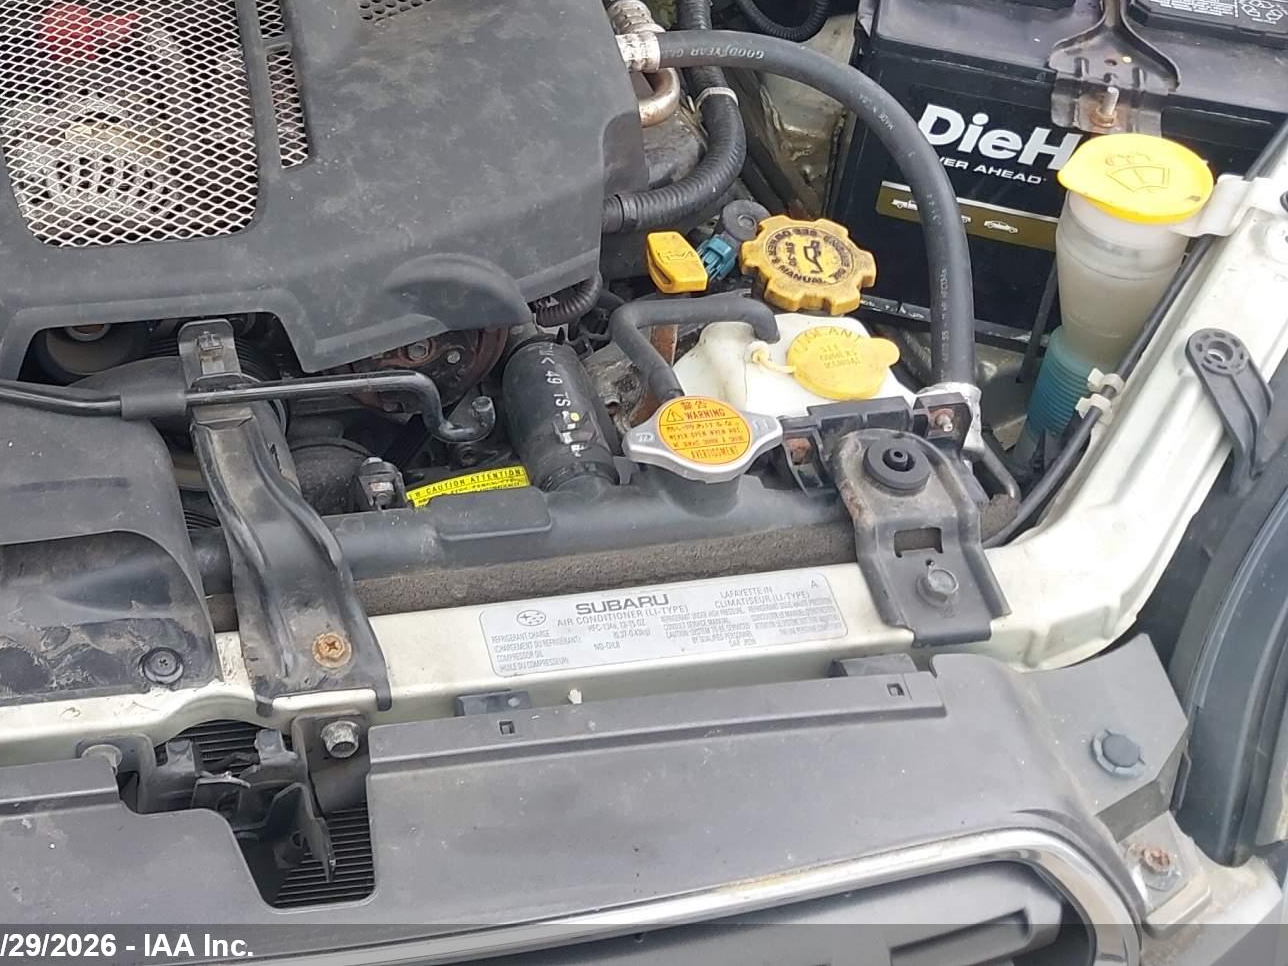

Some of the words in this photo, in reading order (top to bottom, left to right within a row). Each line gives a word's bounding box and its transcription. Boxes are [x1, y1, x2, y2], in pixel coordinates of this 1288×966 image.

[690, 44, 765, 59] GOODYEAR
[918, 103, 1084, 171] DieH
[973, 164, 1042, 185] AHEAD
[685, 409, 726, 420] WARNING
[426, 479, 466, 495] CAUTION
[470, 469, 522, 483] ATTENTION
[576, 594, 669, 616] SUBARU
[714, 596, 772, 609] CLIMATISEUR
[557, 618, 574, 627] AIR
[576, 609, 646, 625] CONDITIONER
